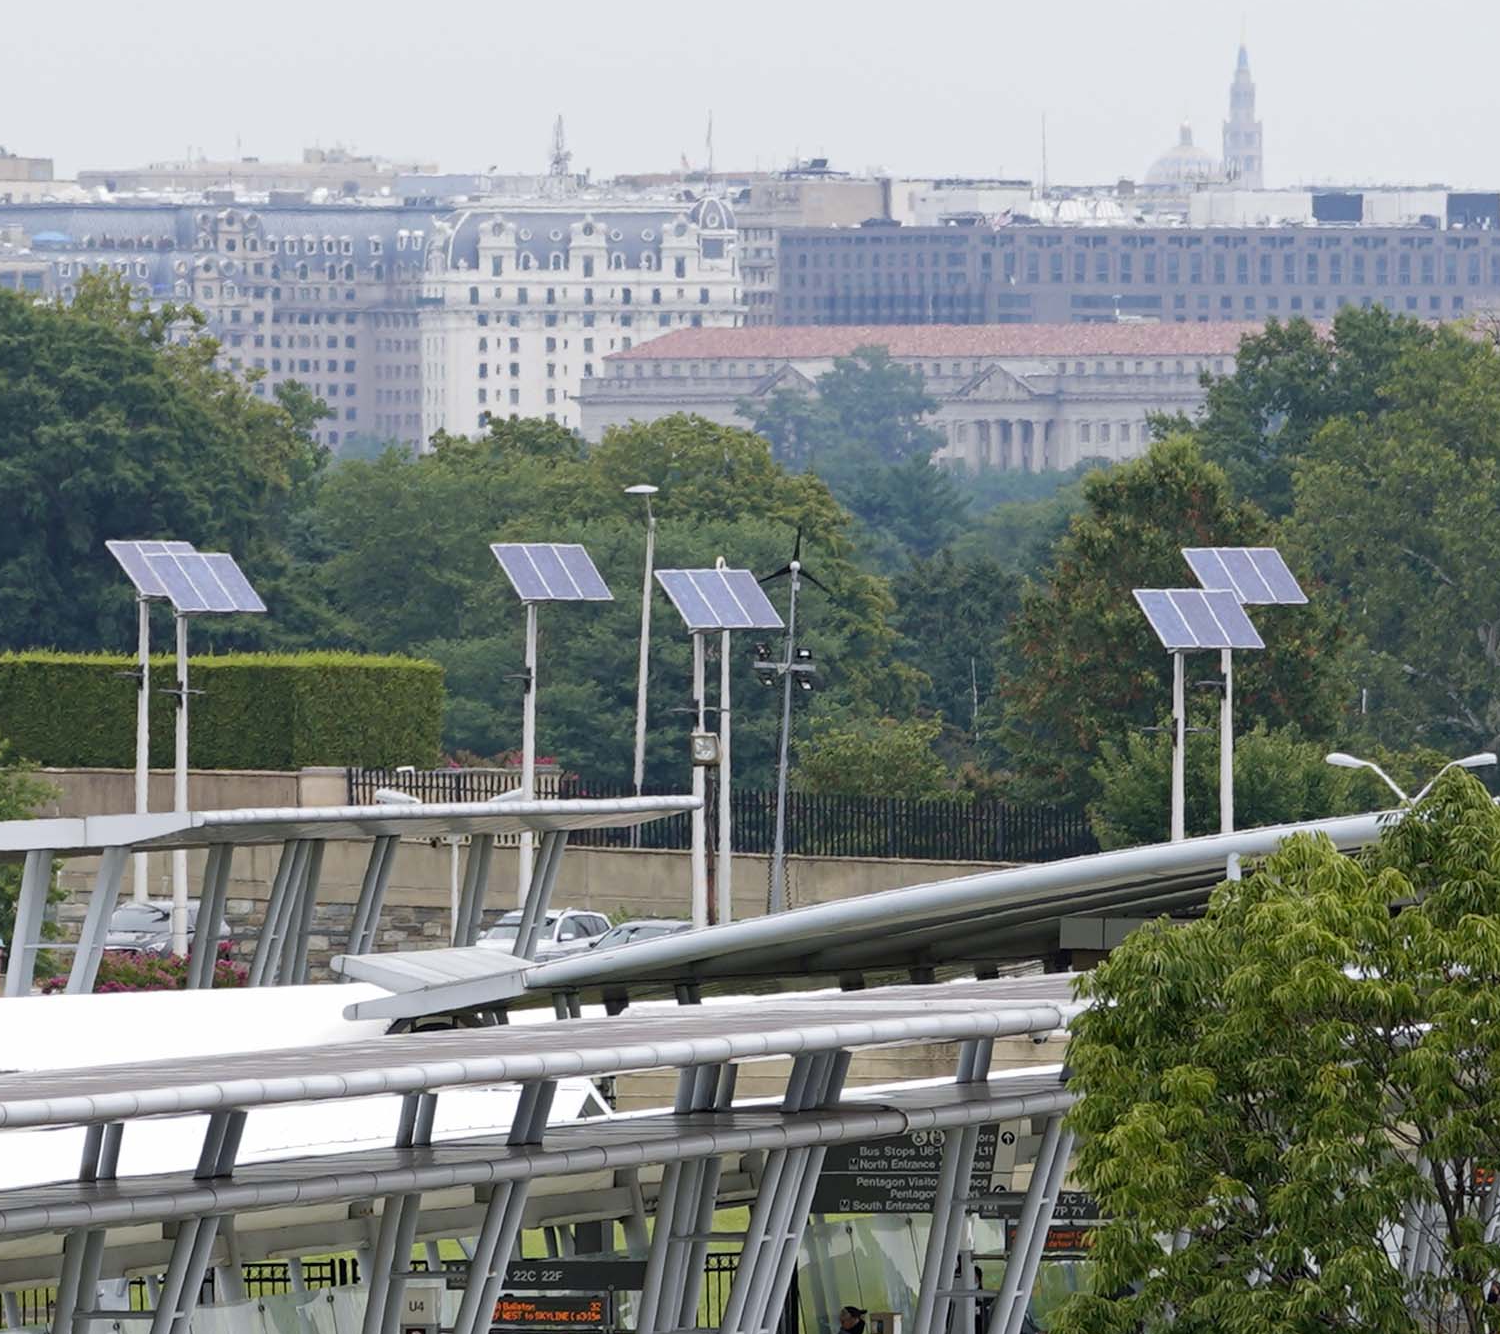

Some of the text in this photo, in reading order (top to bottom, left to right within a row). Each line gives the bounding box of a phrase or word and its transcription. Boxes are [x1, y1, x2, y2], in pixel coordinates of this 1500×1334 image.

[860, 1146, 880, 1157] Bus
[884, 1146, 916, 1158] Stops
[860, 1159, 888, 1170] North
[891, 1158, 936, 1169] Entrance
[856, 1176, 938, 1189] Pentagon Visito
[853, 1200, 883, 1211] South
[885, 1201, 930, 1212] Entrance
[513, 1271, 563, 1281] 22C 22F
[409, 1301, 424, 1313] U4
